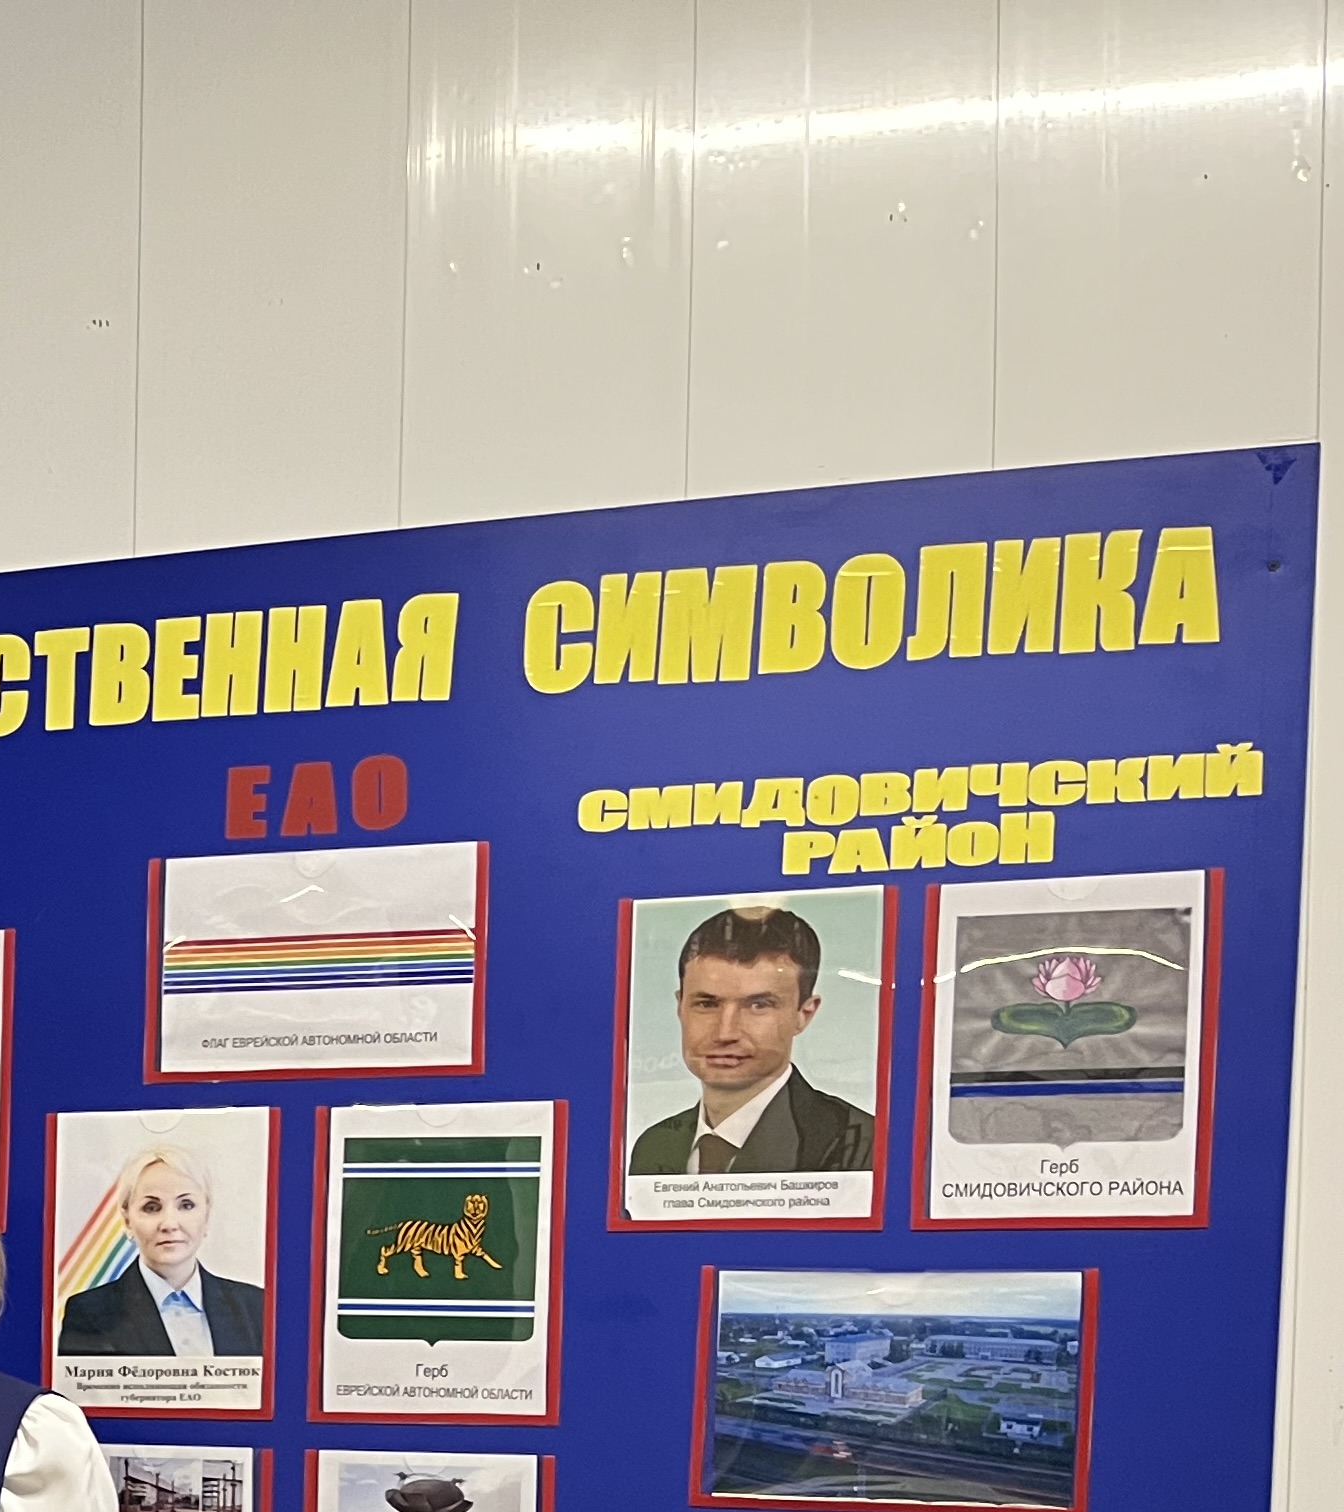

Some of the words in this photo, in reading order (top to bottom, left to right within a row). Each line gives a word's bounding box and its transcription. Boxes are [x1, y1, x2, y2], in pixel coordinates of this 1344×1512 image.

[522, 526, 1222, 695] СИМВОЛИКА
[577, 742, 1265, 834] СМИДОВИЧСКИЙ
[224, 754, 409, 840] ЕАО
[781, 811, 1055, 876] РАЙОН
[201, 1038, 229, 1049] ФЛАГ
[232, 1034, 298, 1048] ЕВРЕЙСКОЙ
[300, 1031, 380, 1047] АВТОНОМНОЙ
[384, 1031, 438, 1044] ОБЛАСТИ
[1040, 1159, 1079, 1176] Герб
[654, 1181, 700, 1193] Евгений
[702, 1181, 777, 1193] Анатольевич
[780, 1179, 839, 1192] Башкиров
[942, 1180, 1103, 1199] СМИДОВИЧСКОГО
[1108, 1178, 1184, 1196] РАЙОНА
[663, 1199, 694, 1208] глава
[697, 1197, 785, 1209] Смидовичского
[788, 1196, 830, 1209] района
[64, 1365, 114, 1379] Мария
[118, 1365, 198, 1380] Фёдоровна
[203, 1365, 261, 1378] Костюк
[415, 1363, 448, 1380] Герб
[179, 1393, 202, 1402] ЕАО
[336, 1384, 400, 1397] ЕВРЕЙСКОЙ
[402, 1385, 478, 1400] АВТОНОМНОЙ
[481, 1387, 533, 1400] ОБЛАСТИ
